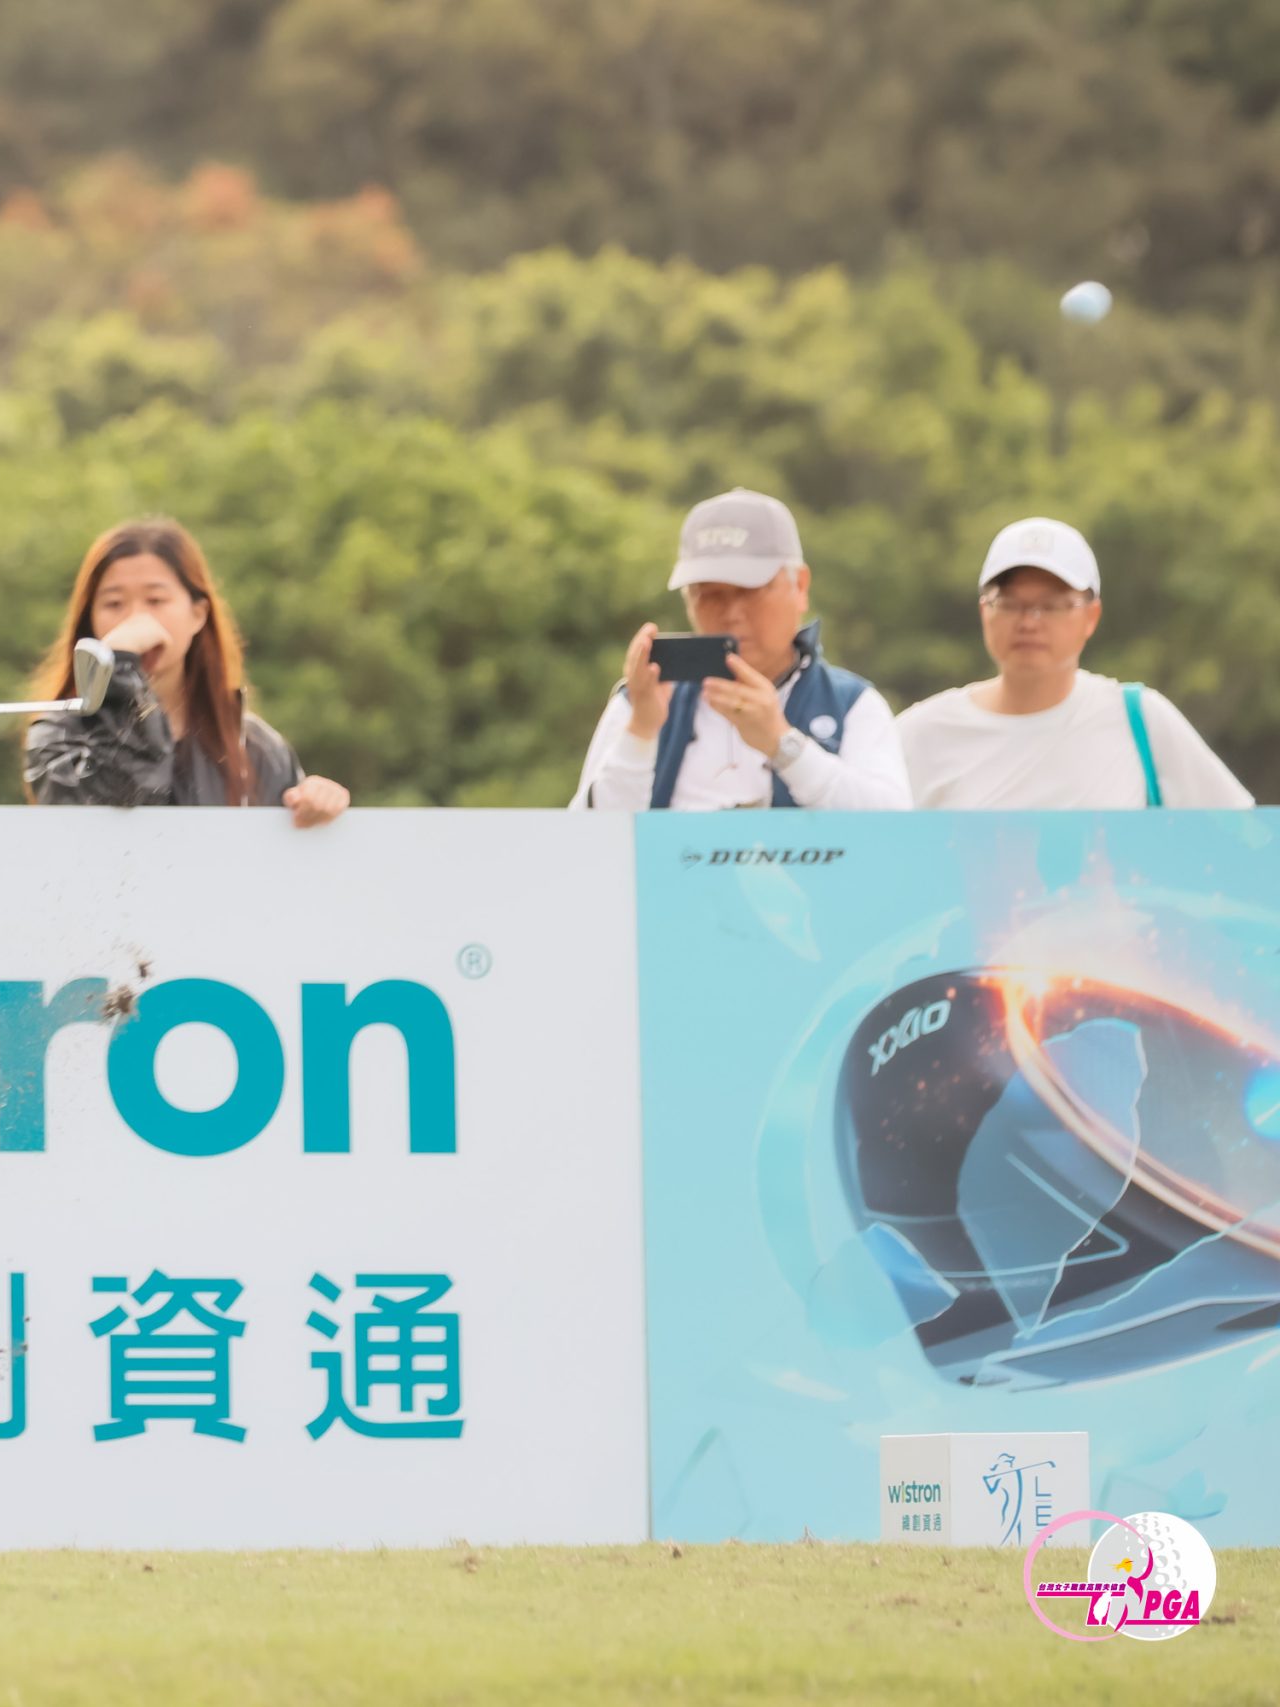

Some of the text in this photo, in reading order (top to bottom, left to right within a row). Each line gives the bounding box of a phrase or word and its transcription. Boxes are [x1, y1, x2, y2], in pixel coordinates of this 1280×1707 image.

[708, 848, 846, 865] DUNLOP
[888, 1480, 941, 1504] wistron
[1035, 1475, 1052, 1548] LE
